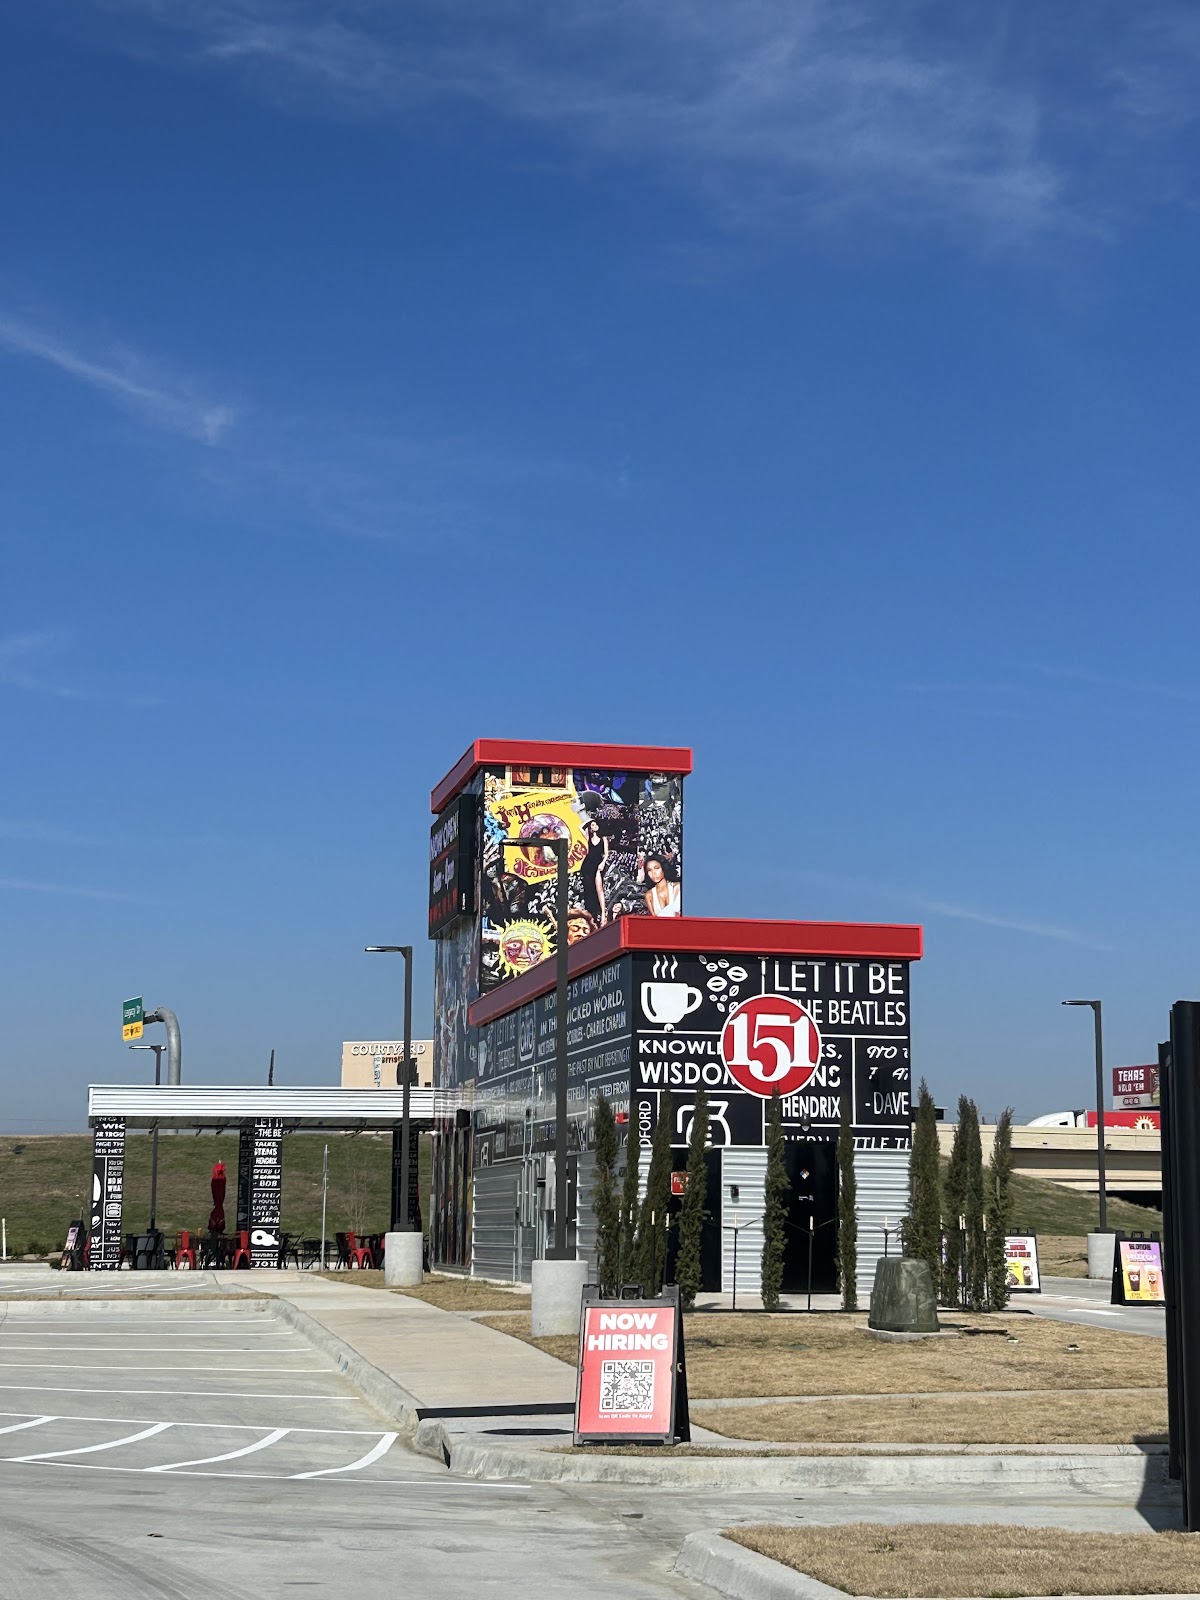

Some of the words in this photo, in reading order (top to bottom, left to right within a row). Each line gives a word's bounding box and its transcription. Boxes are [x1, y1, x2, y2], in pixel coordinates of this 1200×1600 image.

[774, 960, 826, 992] LET
[835, 962, 860, 993] IT
[868, 963, 904, 995] BE
[593, 989, 625, 1015] WORLD,
[828, 999, 906, 1026] BEATLES
[727, 1012, 816, 1083] 151
[1118, 1069, 1144, 1081] TEXAS
[613, 1079, 630, 1096] FROM
[782, 1095, 842, 1118] HENDRIX
[254, 1118, 273, 1128] LET
[600, 1313, 657, 1331] NOW
[587, 1333, 668, 1351] HIRING
